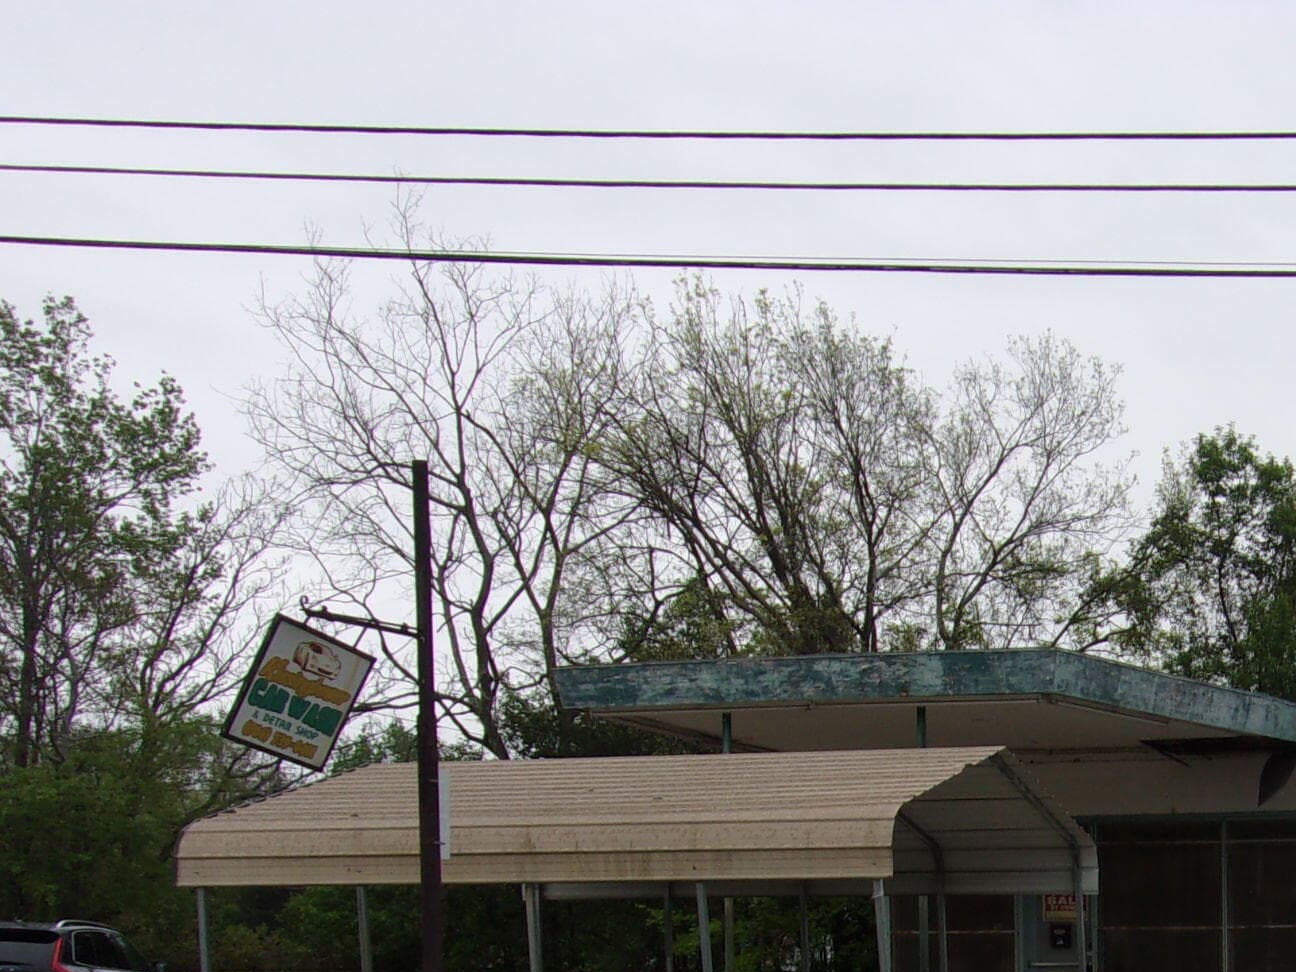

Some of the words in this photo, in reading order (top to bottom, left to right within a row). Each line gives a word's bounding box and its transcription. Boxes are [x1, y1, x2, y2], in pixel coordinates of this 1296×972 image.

[262, 713, 293, 731] DETAIL
[295, 725, 320, 741] SHOP
[1046, 895, 1076, 905] SAL
